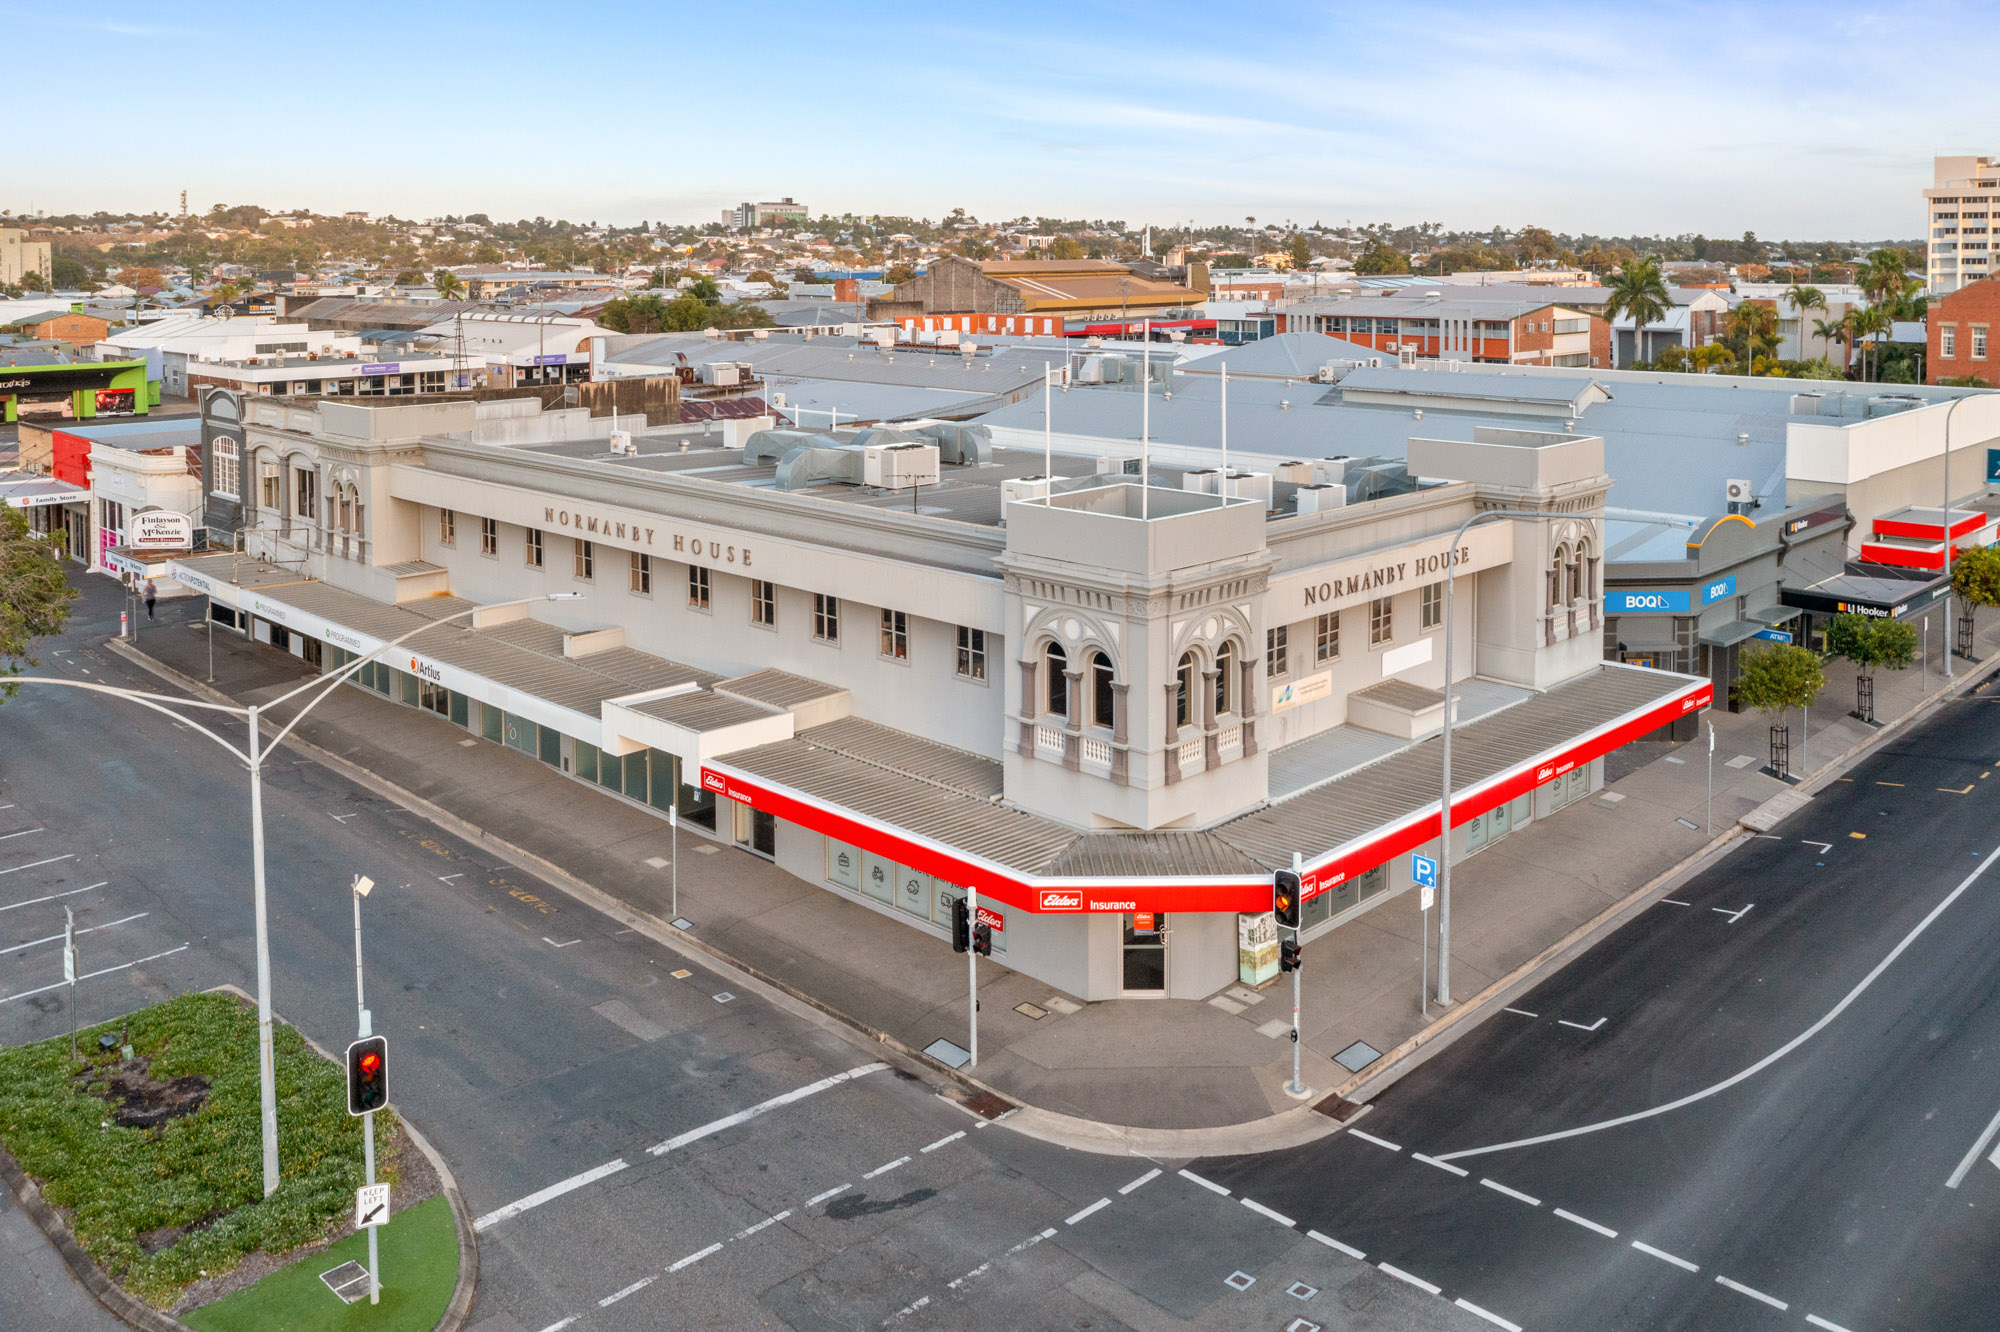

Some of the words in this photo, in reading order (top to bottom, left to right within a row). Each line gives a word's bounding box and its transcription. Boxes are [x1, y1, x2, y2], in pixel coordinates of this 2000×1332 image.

[36, 496, 57, 504] Family
[59, 494, 77, 502] Store
[141, 516, 181, 525] Finlayson
[545, 507, 655, 545] NORMANBY
[673, 534, 753, 567] HOUSE
[1304, 562, 1406, 607] NORMANBY
[1415, 547, 1469, 576] HOUSE
[1711, 583, 1724, 599] BOQ
[1626, 596, 1657, 609] BOQ
[1848, 603, 1856, 615] LJ
[1856, 603, 1889, 618] Hooker
[1769, 633, 1784, 642] ATM
[419, 661, 441, 681] Artius
[1538, 768, 1553, 780] Elders
[1556, 761, 1575, 775] Insurance
[705, 775, 724, 789] Elders
[727, 786, 752, 804] Insurance
[1416, 858, 1432, 880] P
[1319, 871, 1345, 891] Insurance
[1043, 894, 1080, 907] Elders
[1089, 900, 1137, 910] Insurance
[977, 909, 1002, 928] Elders
[363, 1187, 385, 1197] KEEP
[363, 1196, 383, 1205] LEFT
